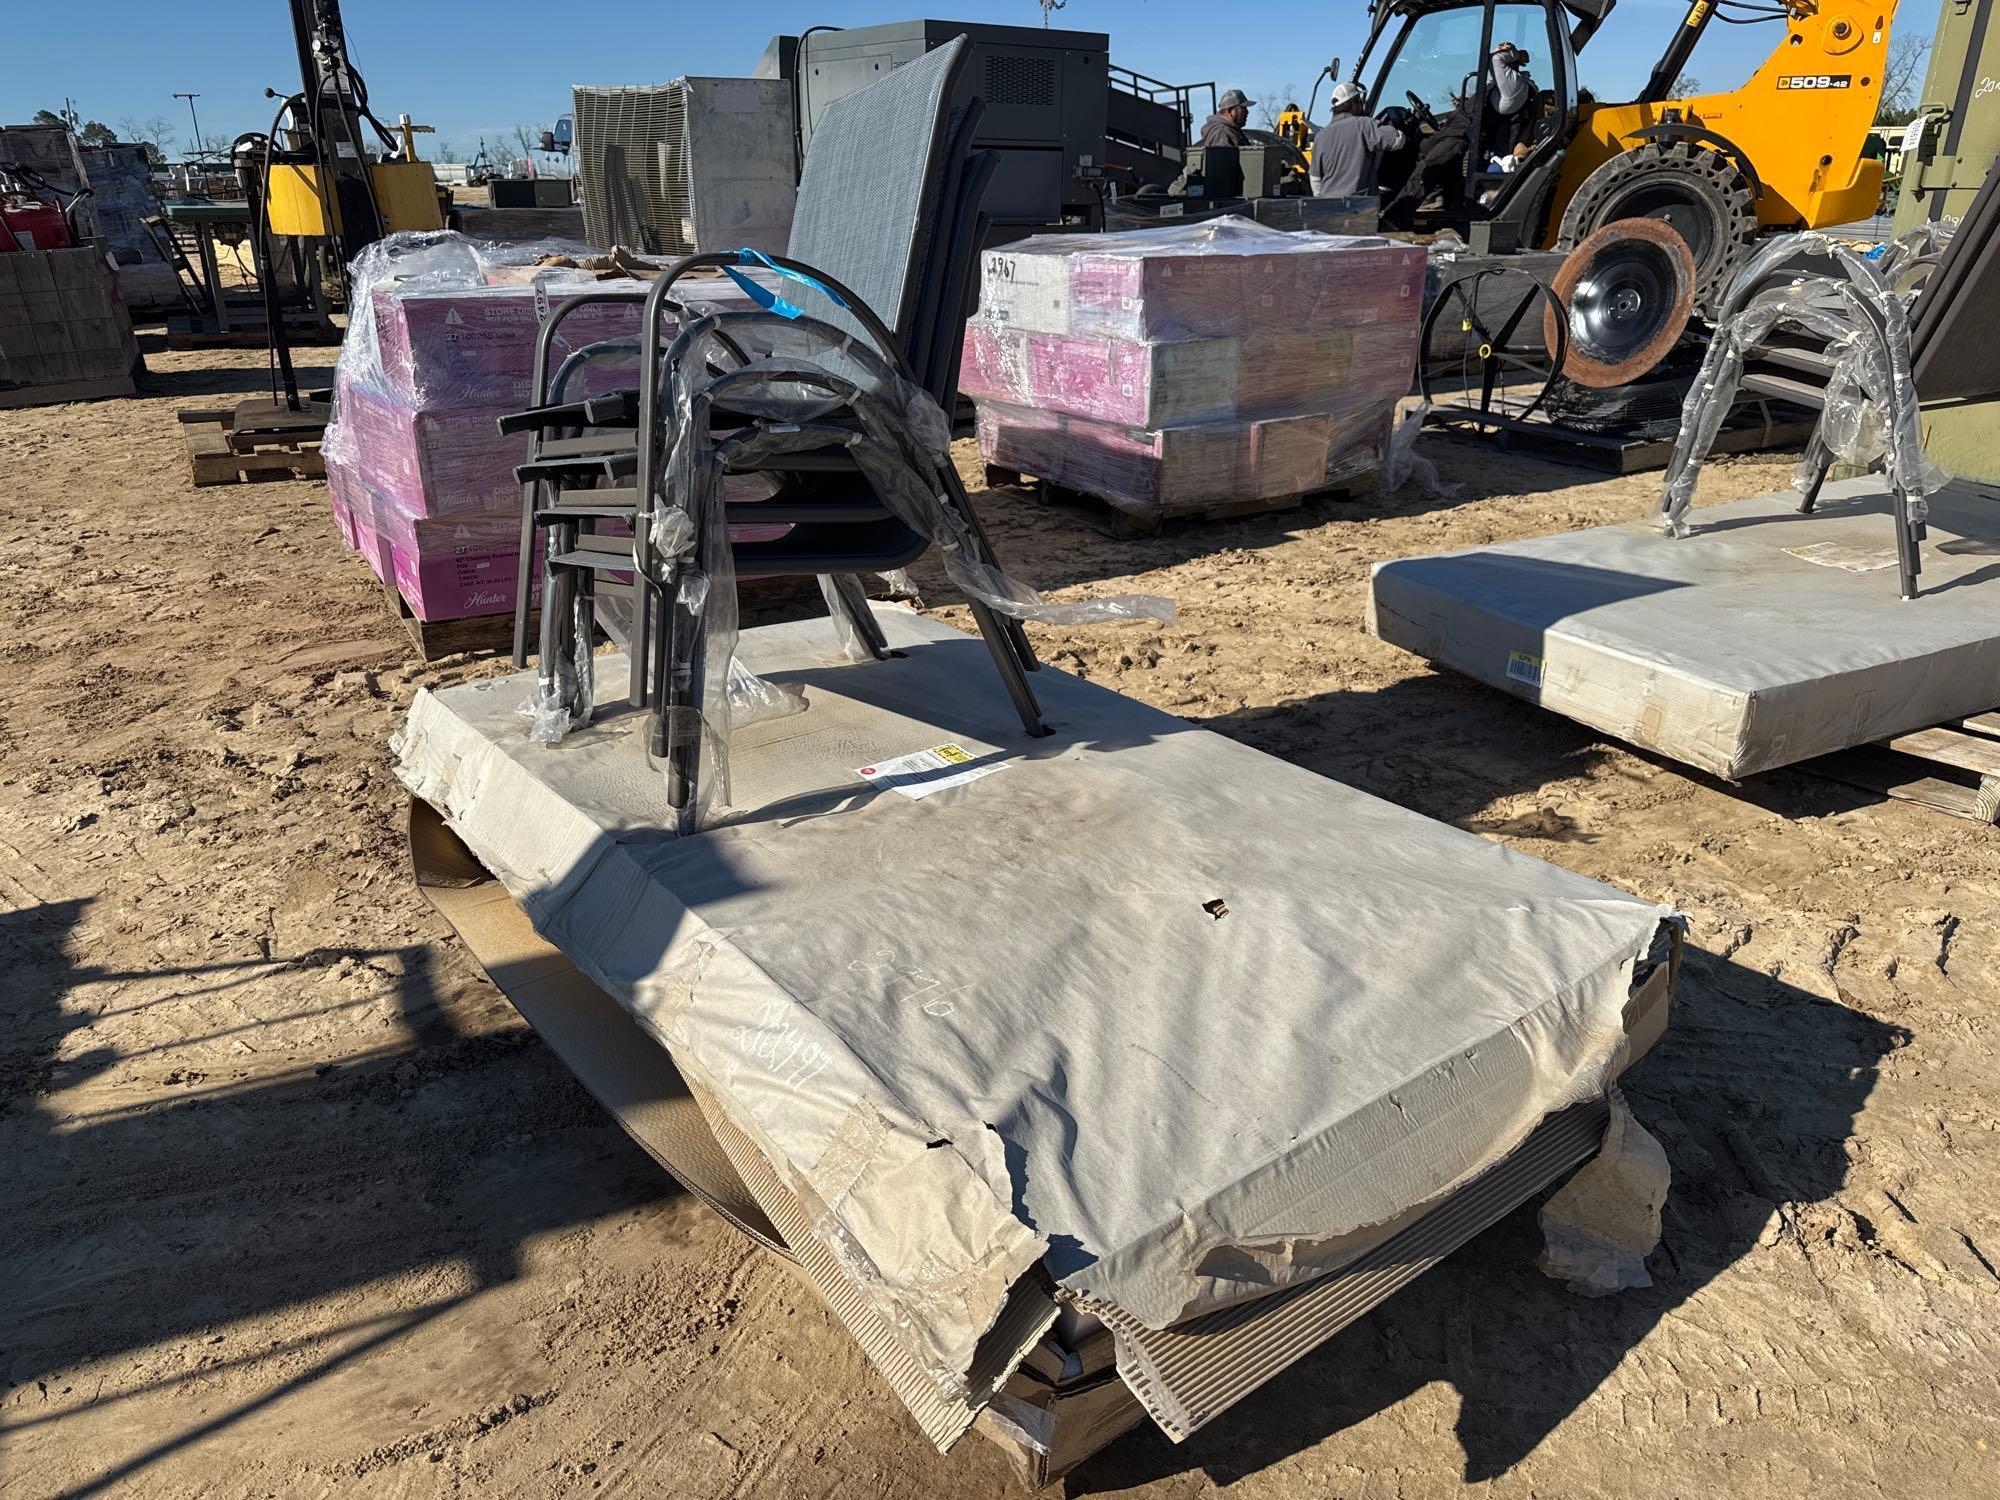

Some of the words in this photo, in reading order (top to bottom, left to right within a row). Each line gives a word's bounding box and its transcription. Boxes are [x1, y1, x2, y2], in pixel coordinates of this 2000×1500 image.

[1790, 76, 1848, 88] 509-42
[537, 289, 547, 321] 2497
[464, 590, 506, 609] Hunter
